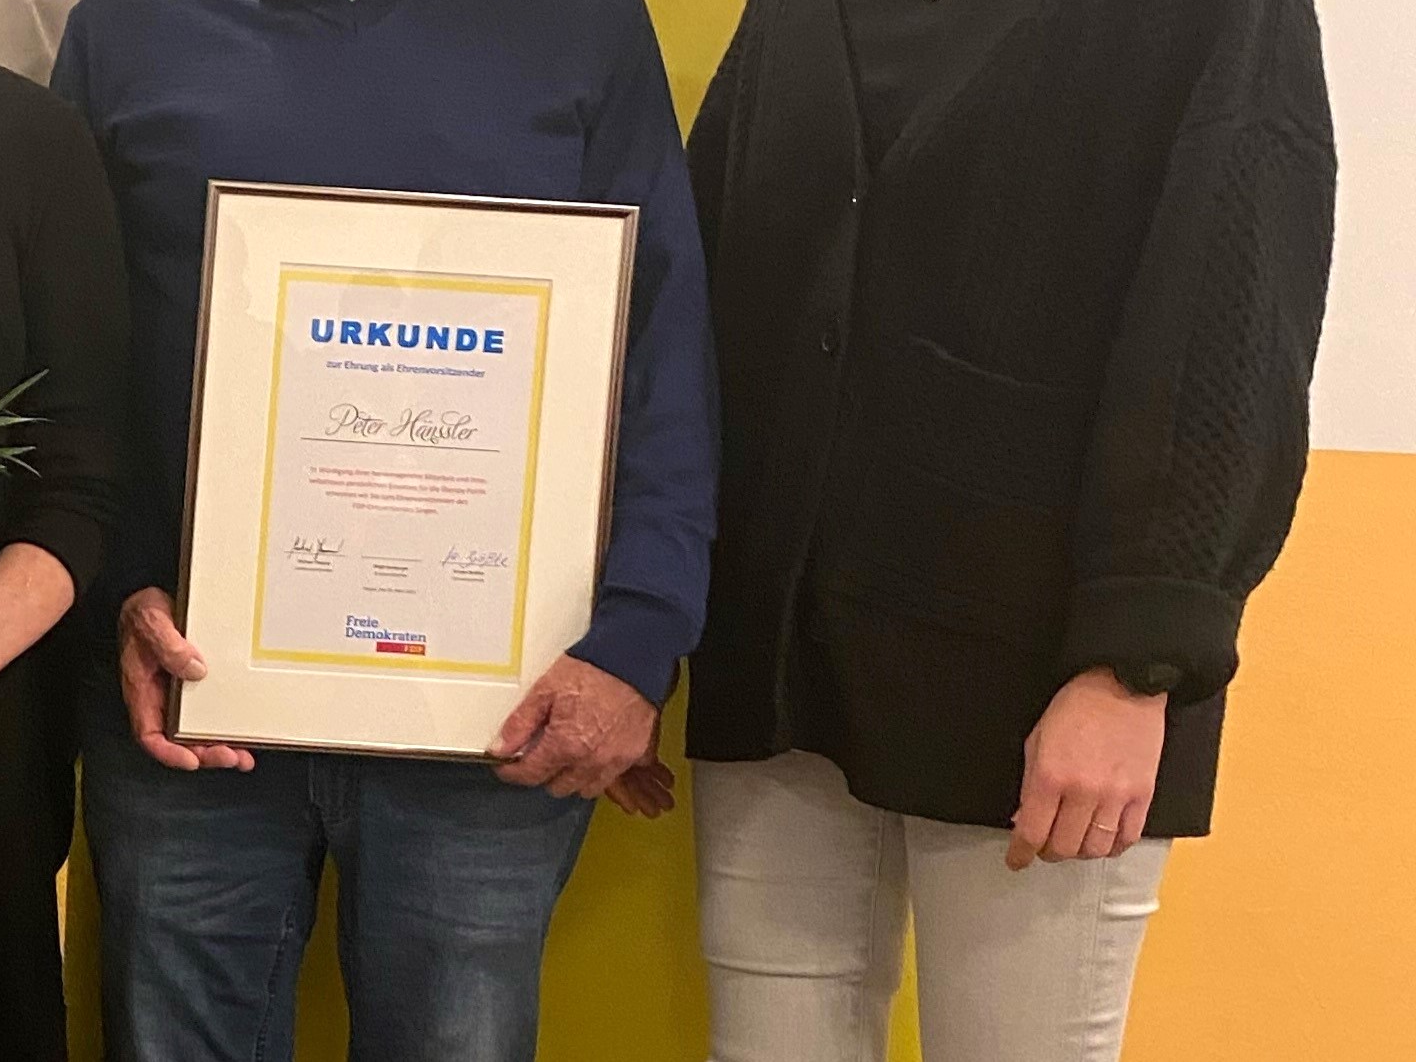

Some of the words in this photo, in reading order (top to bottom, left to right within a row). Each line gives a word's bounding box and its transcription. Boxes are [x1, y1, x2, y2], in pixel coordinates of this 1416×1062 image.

[310, 318, 505, 354] URKUNDE
[326, 361, 342, 369] zur
[344, 360, 379, 373] Ehrung
[380, 362, 395, 372] als
[325, 403, 387, 437] Peter
[346, 615, 379, 628] Freie
[345, 626, 427, 643] Demokraten
